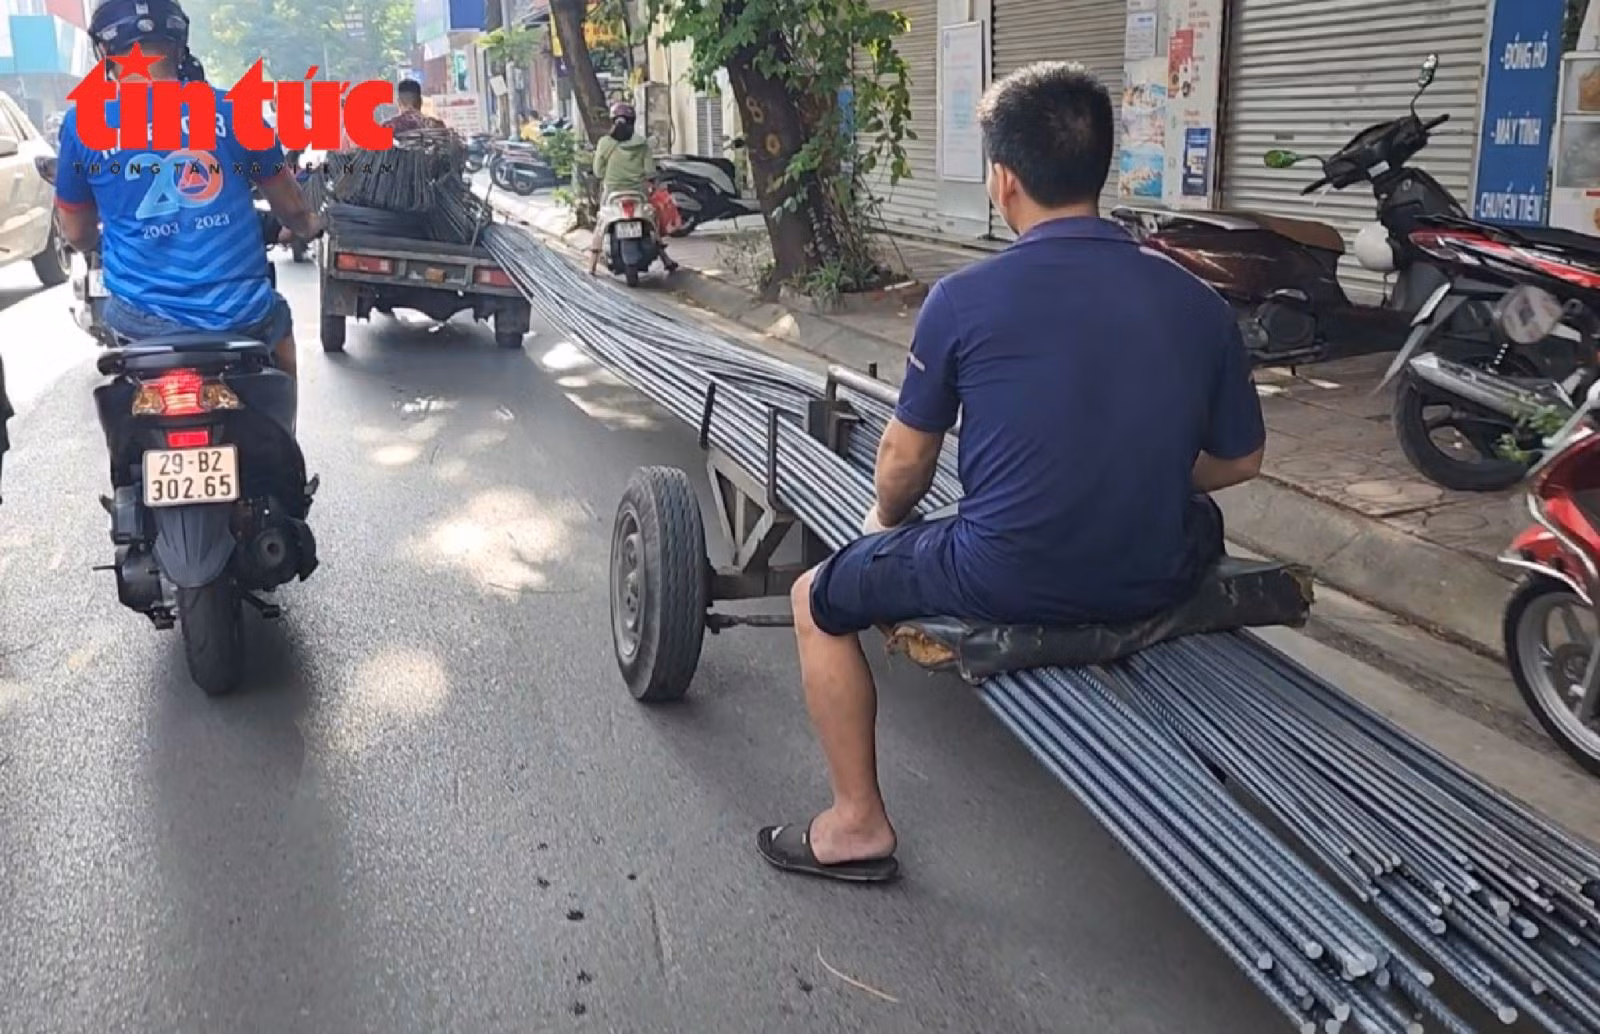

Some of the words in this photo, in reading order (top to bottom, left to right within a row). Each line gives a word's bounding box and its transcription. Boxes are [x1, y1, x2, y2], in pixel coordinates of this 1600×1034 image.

[142, 222, 180, 240] 2003
[195, 213, 231, 231] 2023
[159, 450, 223, 476] 29-B2
[152, 474, 232, 501] 302.65
